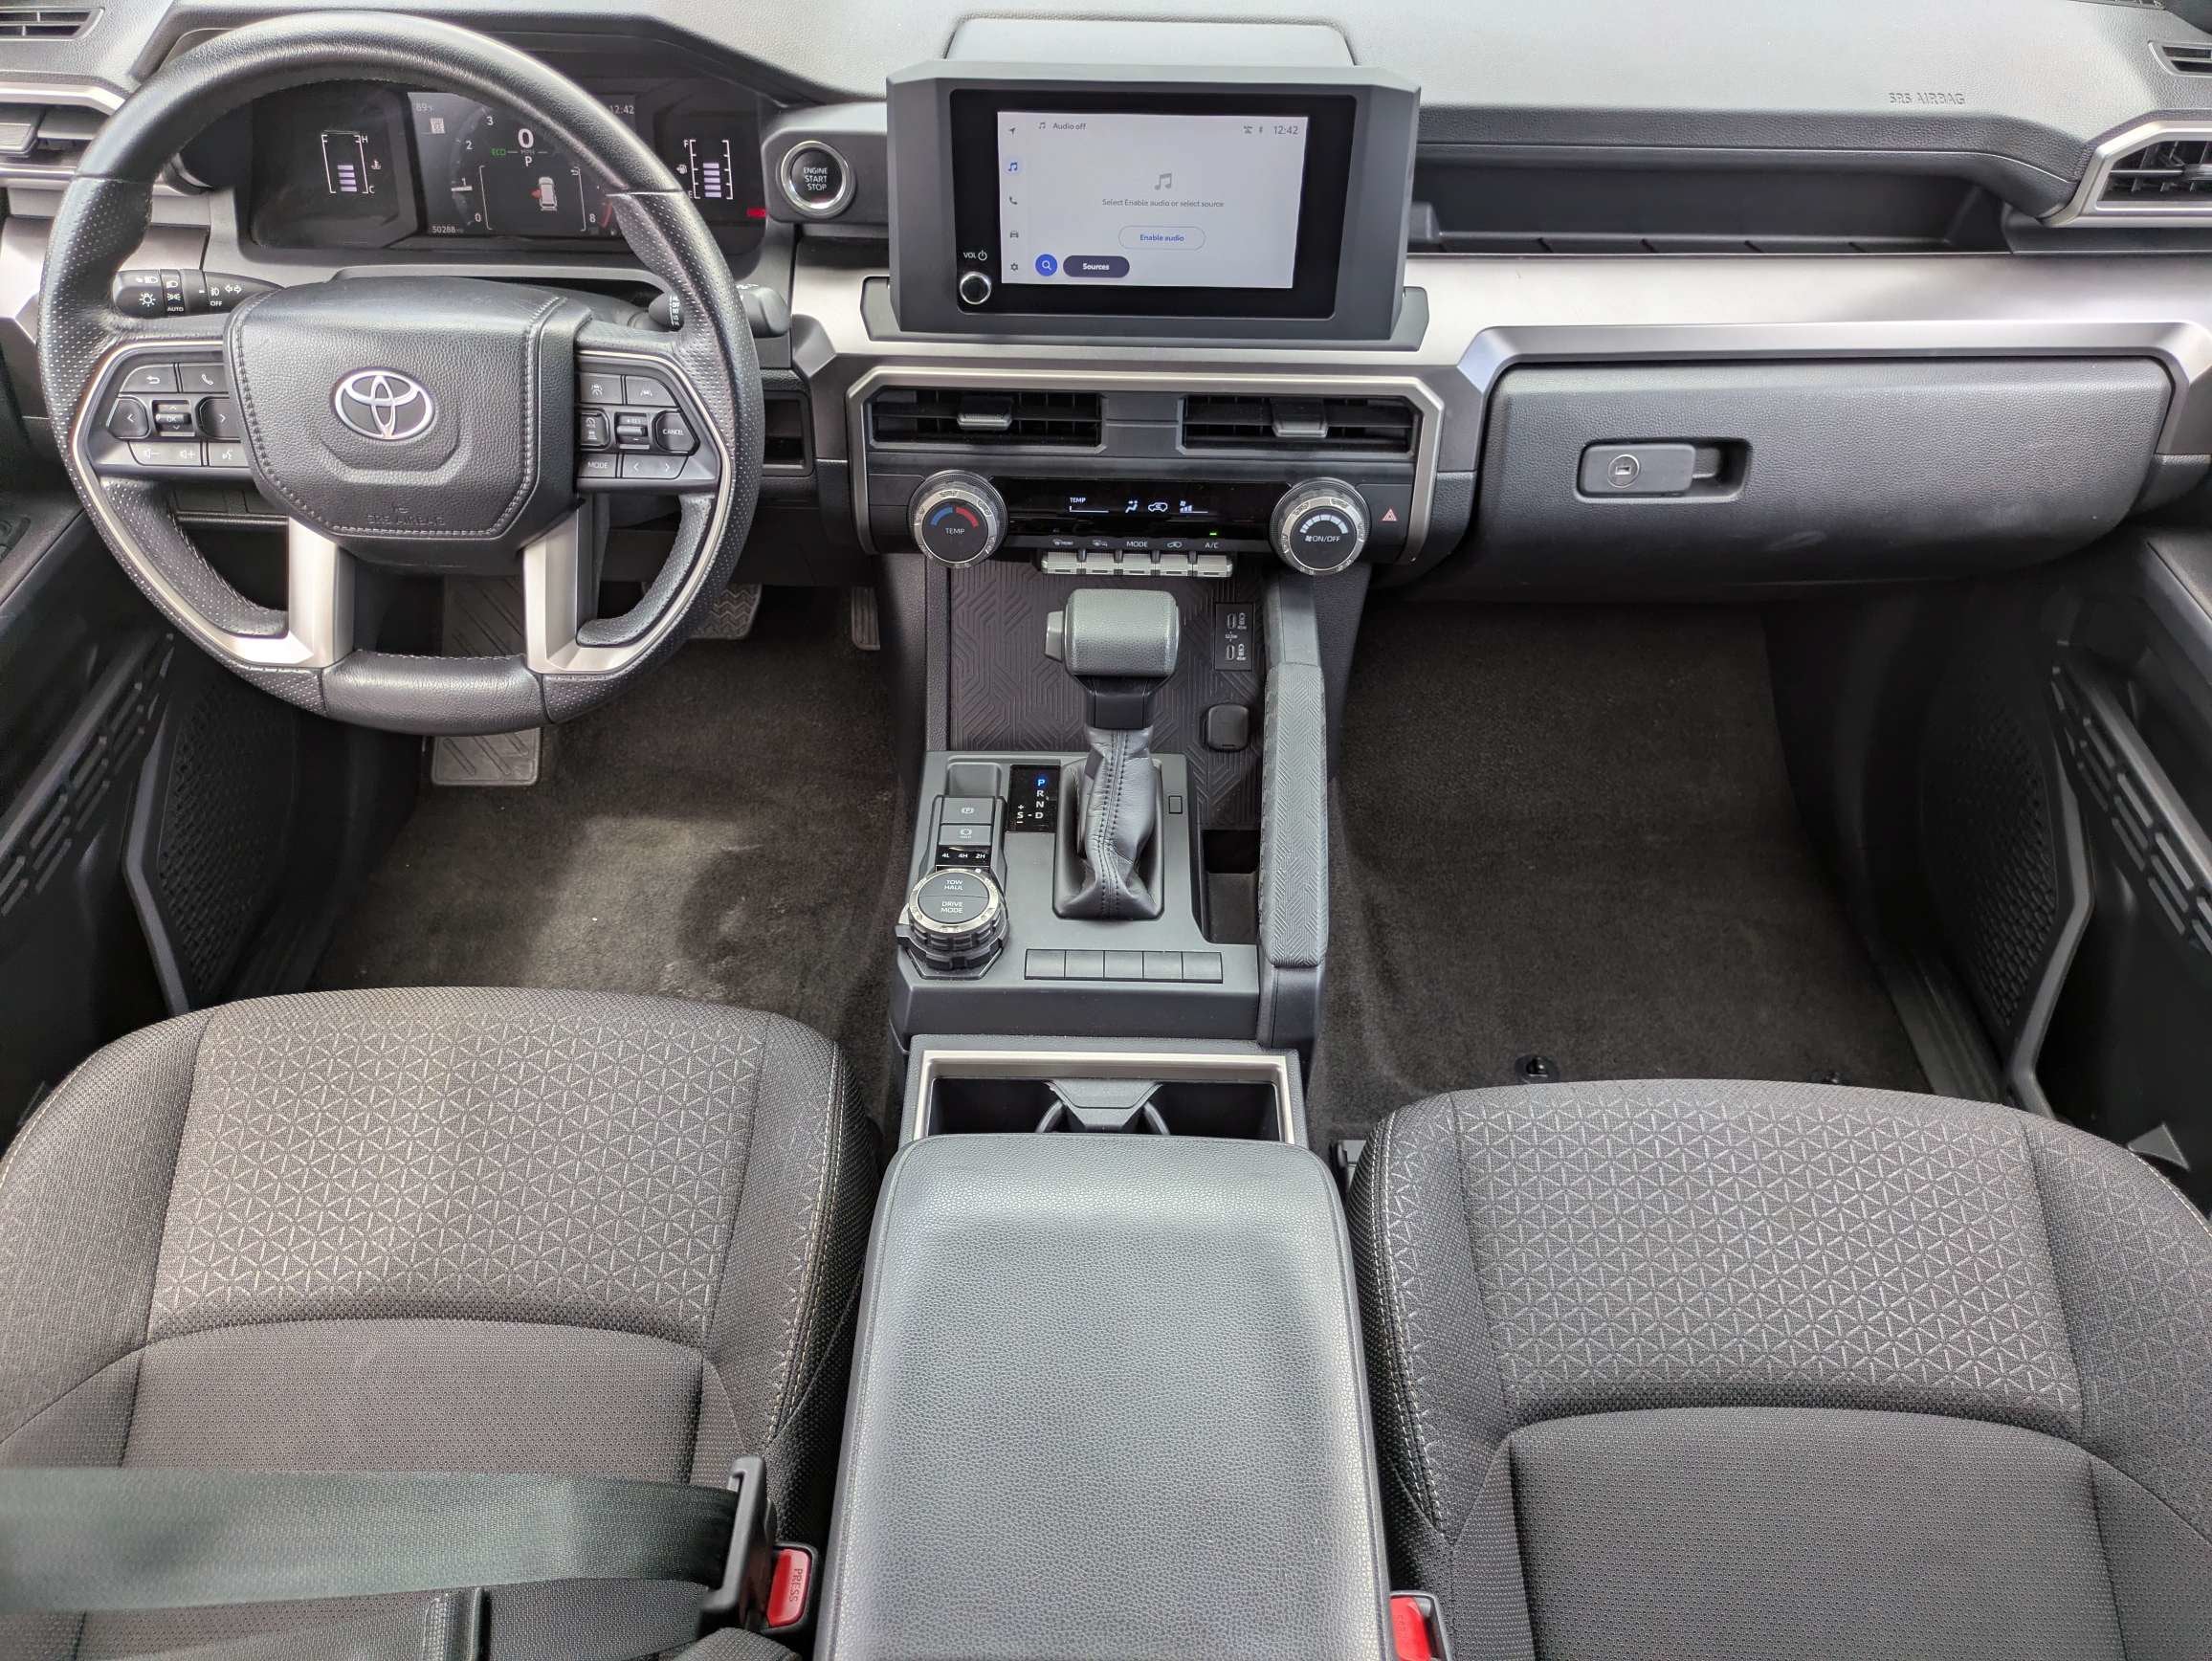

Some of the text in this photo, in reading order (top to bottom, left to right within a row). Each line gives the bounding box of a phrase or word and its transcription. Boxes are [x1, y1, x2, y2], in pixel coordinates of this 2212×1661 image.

[1889, 92, 1965, 105] SRS AIRBAG
[486, 116, 495, 126] 3
[1052, 122, 1074, 130] Audio
[1273, 125, 1298, 135] 12:42
[362, 135, 368, 144] H
[518, 128, 534, 148] 0
[466, 140, 474, 150] 2
[683, 140, 689, 148] F
[524, 156, 533, 167] P
[368, 186, 375, 194] C
[807, 183, 827, 191] STOP
[1102, 198, 1123, 207] Select
[1124, 198, 1148, 207] Enable
[1150, 199, 1169, 208] audio
[475, 212, 482, 223] 0
[589, 212, 596, 223] 8
[1139, 233, 1163, 242] Enable
[1082, 262, 1110, 271] Sources
[662, 428, 684, 436] CANCEL
[788, 1568, 804, 1603] PRESS
